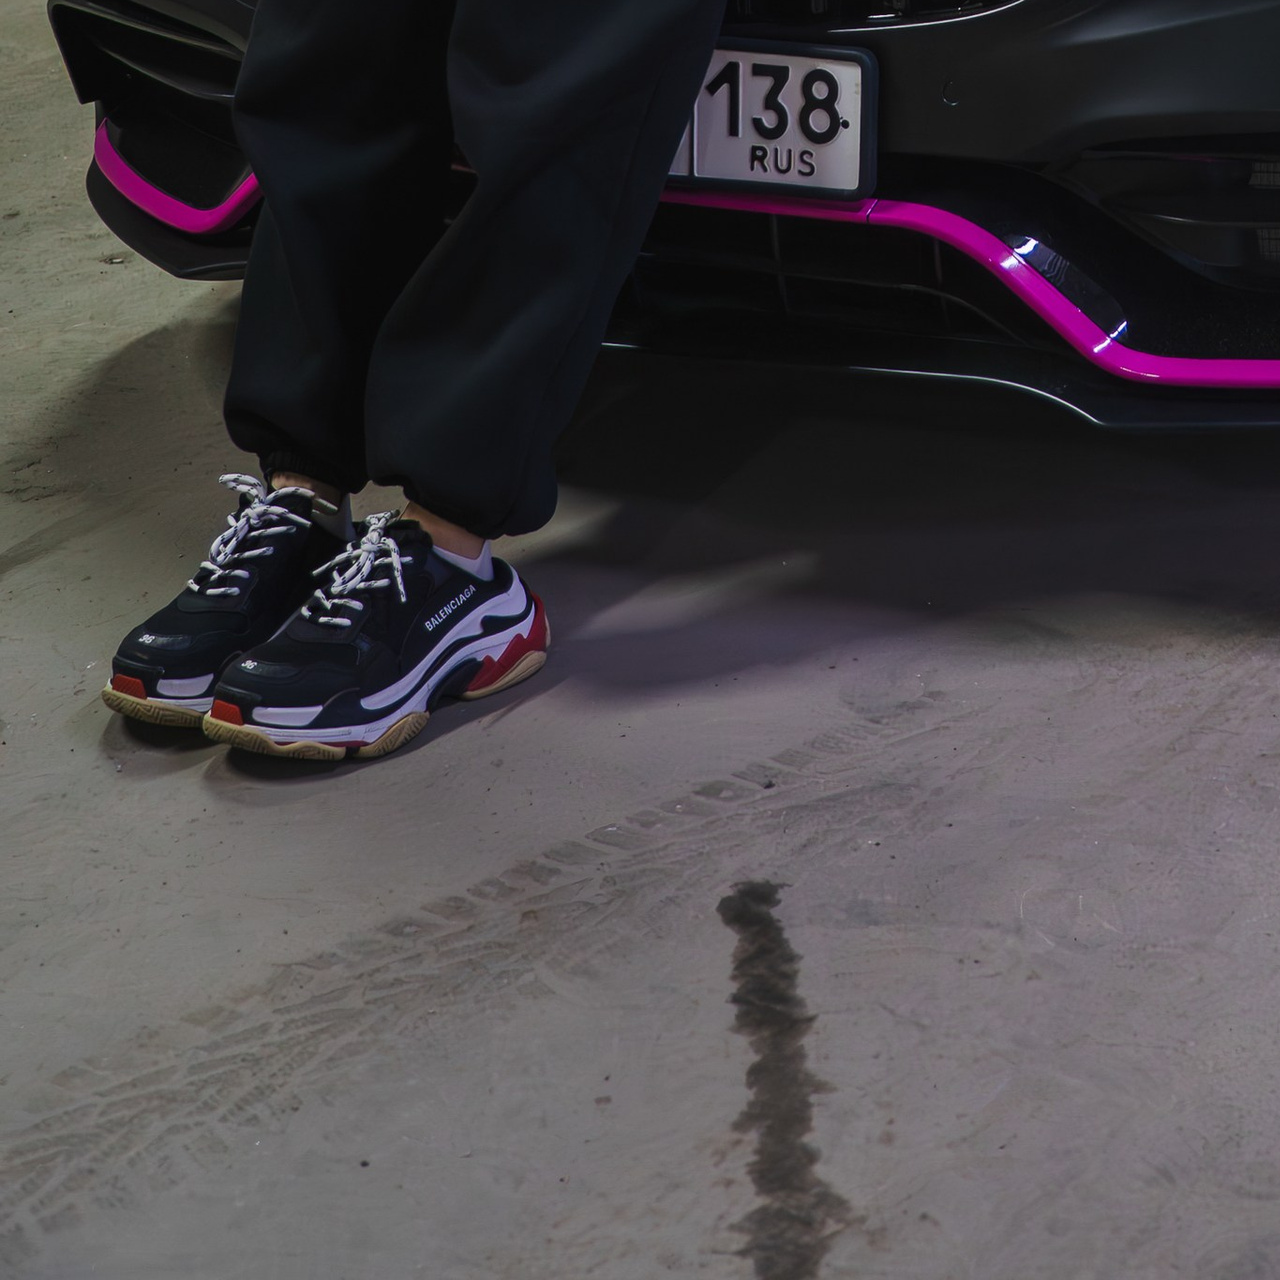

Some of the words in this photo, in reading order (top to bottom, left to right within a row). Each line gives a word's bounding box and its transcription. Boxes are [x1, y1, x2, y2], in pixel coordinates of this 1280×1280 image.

[706, 61, 841, 145] 138
[750, 144, 816, 177] RUS
[424, 584, 477, 632] BALENCIAGA
